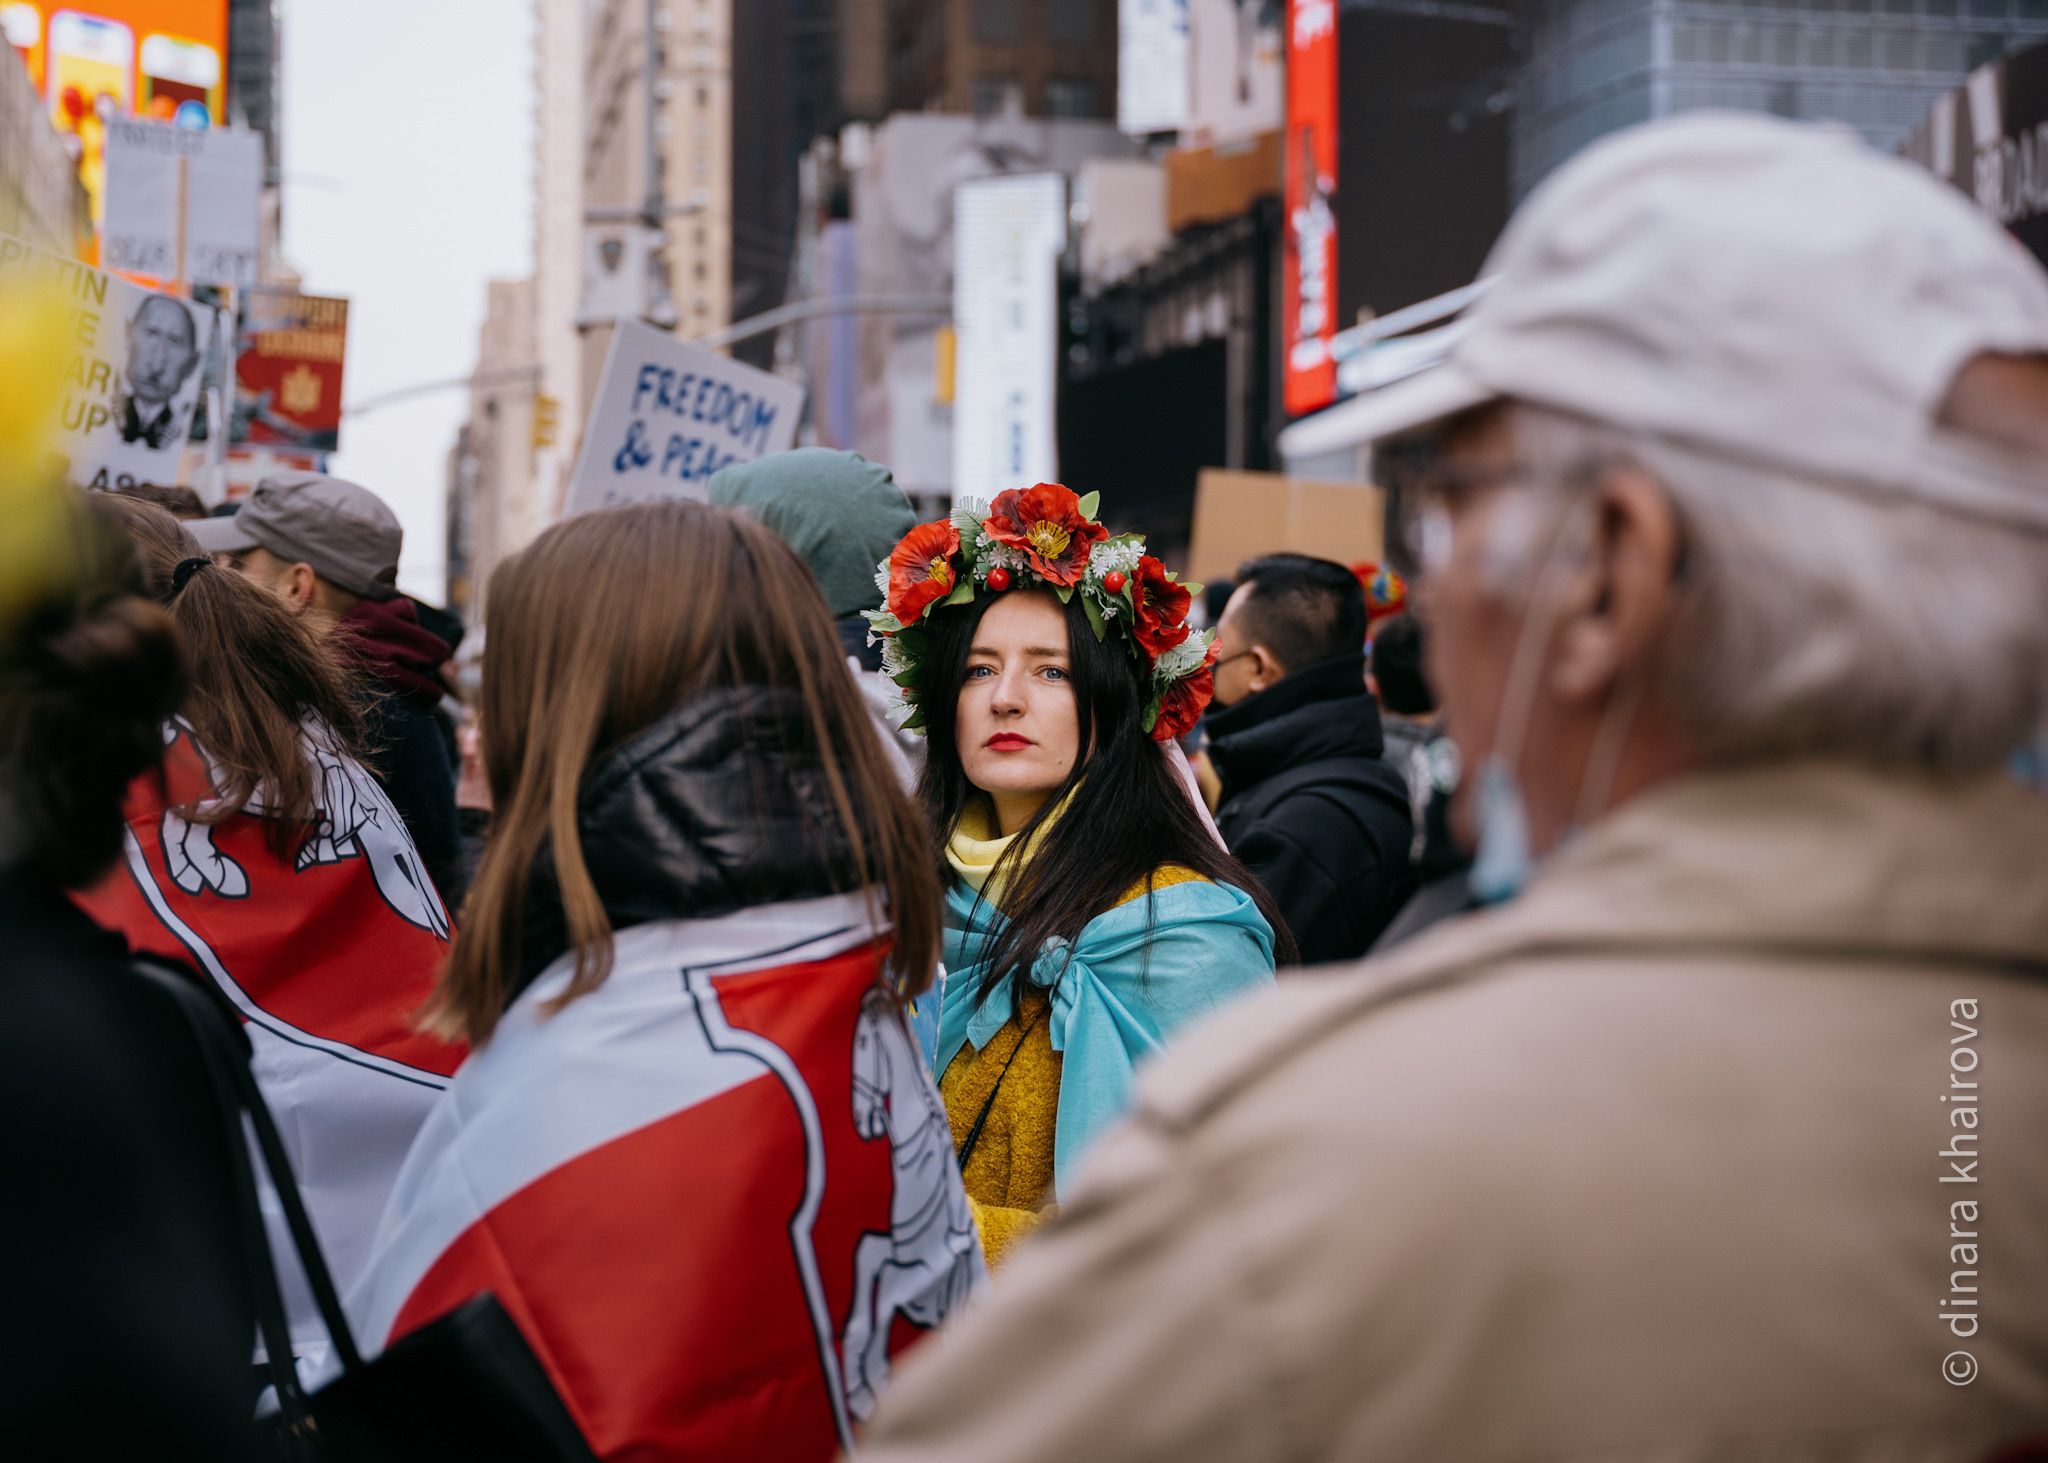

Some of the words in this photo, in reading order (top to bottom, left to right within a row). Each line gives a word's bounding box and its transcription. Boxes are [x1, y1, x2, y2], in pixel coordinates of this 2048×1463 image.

[61, 397, 109, 434] UP
[632, 365, 776, 452] FREEDOM
[613, 420, 652, 474] &
[659, 433, 745, 490] PEA
